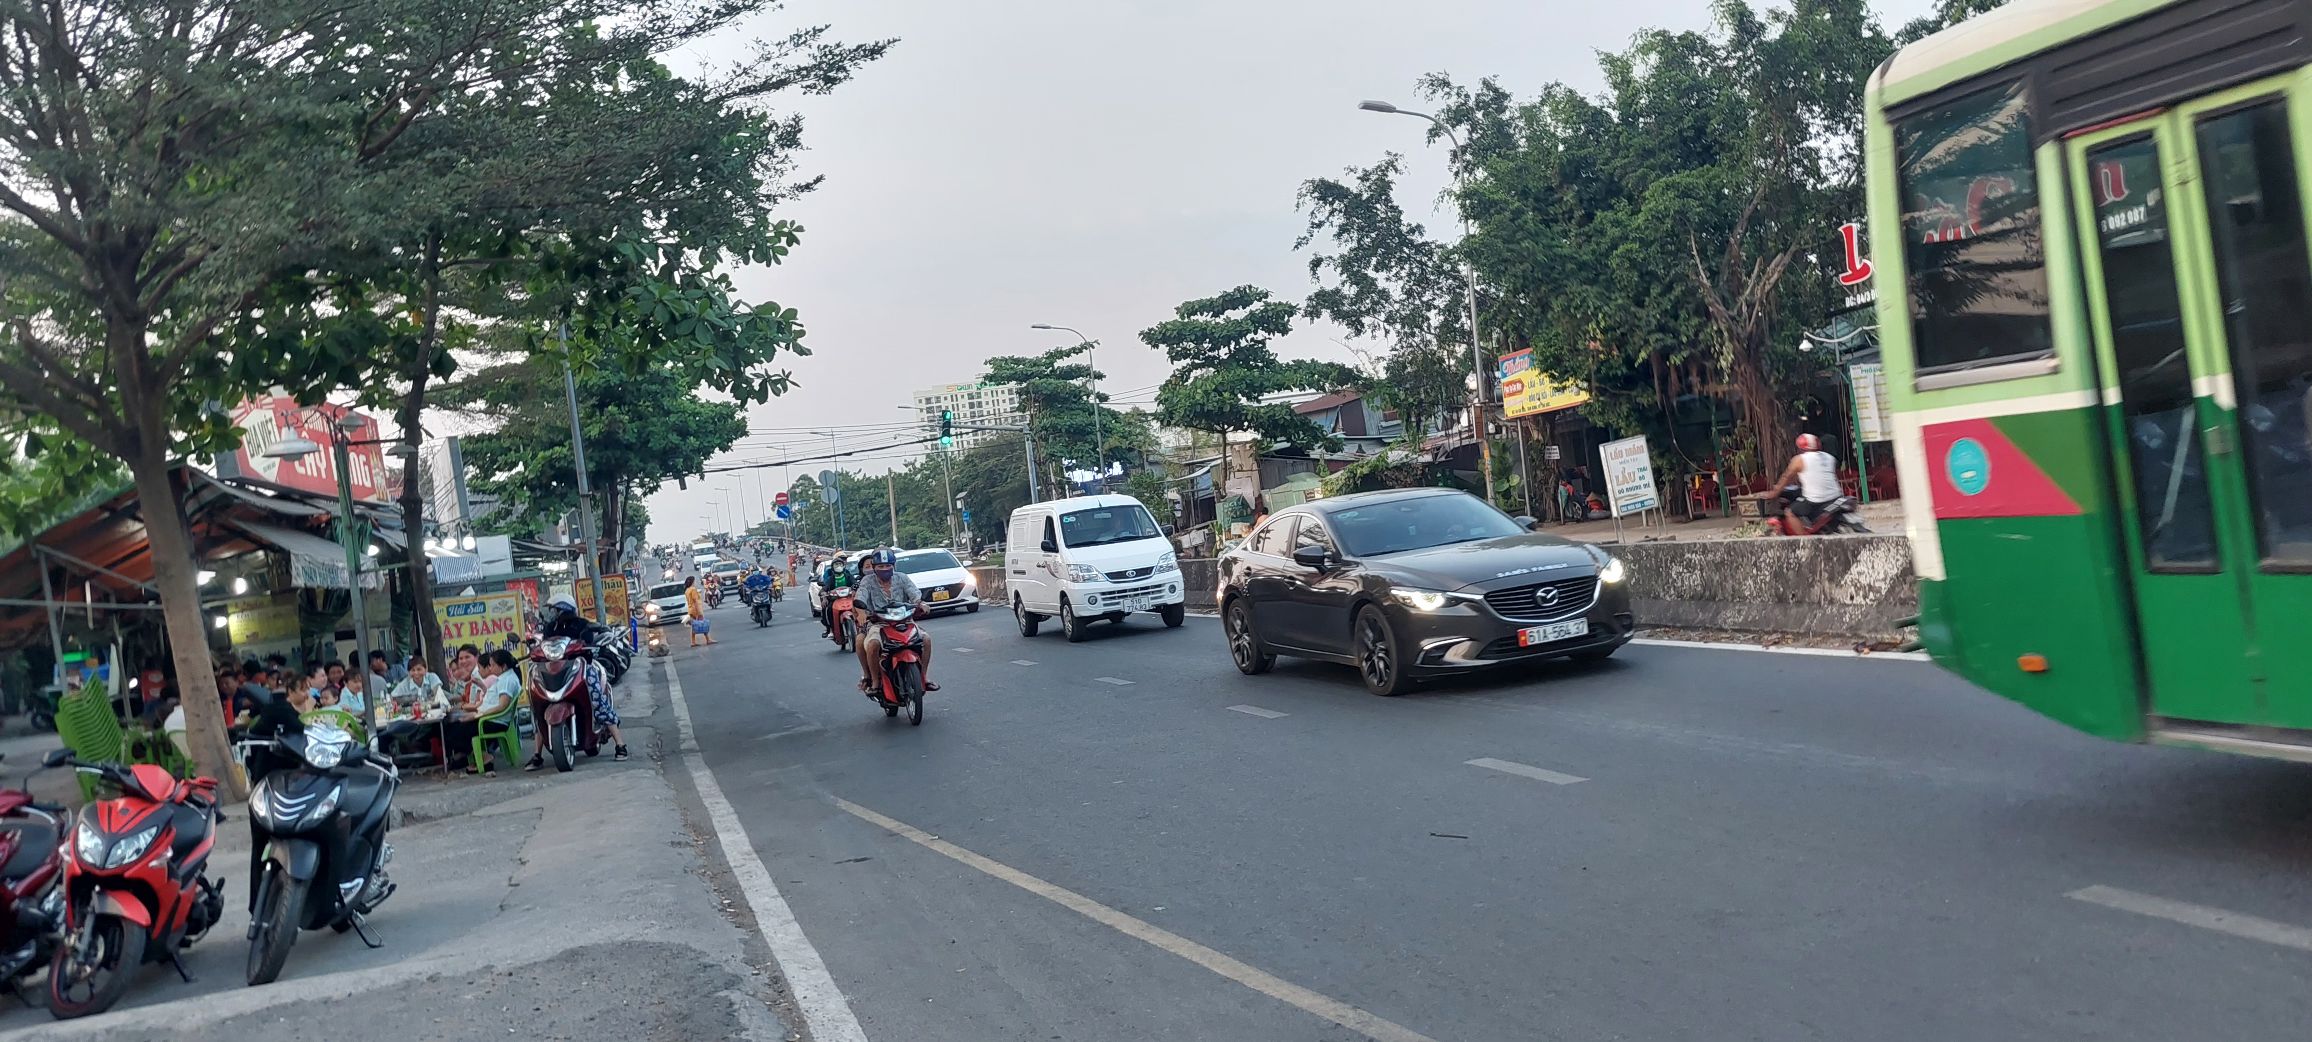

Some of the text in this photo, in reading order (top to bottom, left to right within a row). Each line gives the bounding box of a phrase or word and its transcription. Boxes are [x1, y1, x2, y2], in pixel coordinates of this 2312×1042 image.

[329, 444, 372, 488] NG
[601, 579, 623, 592] hậu
[443, 615, 514, 639] ÂY BÀNG
